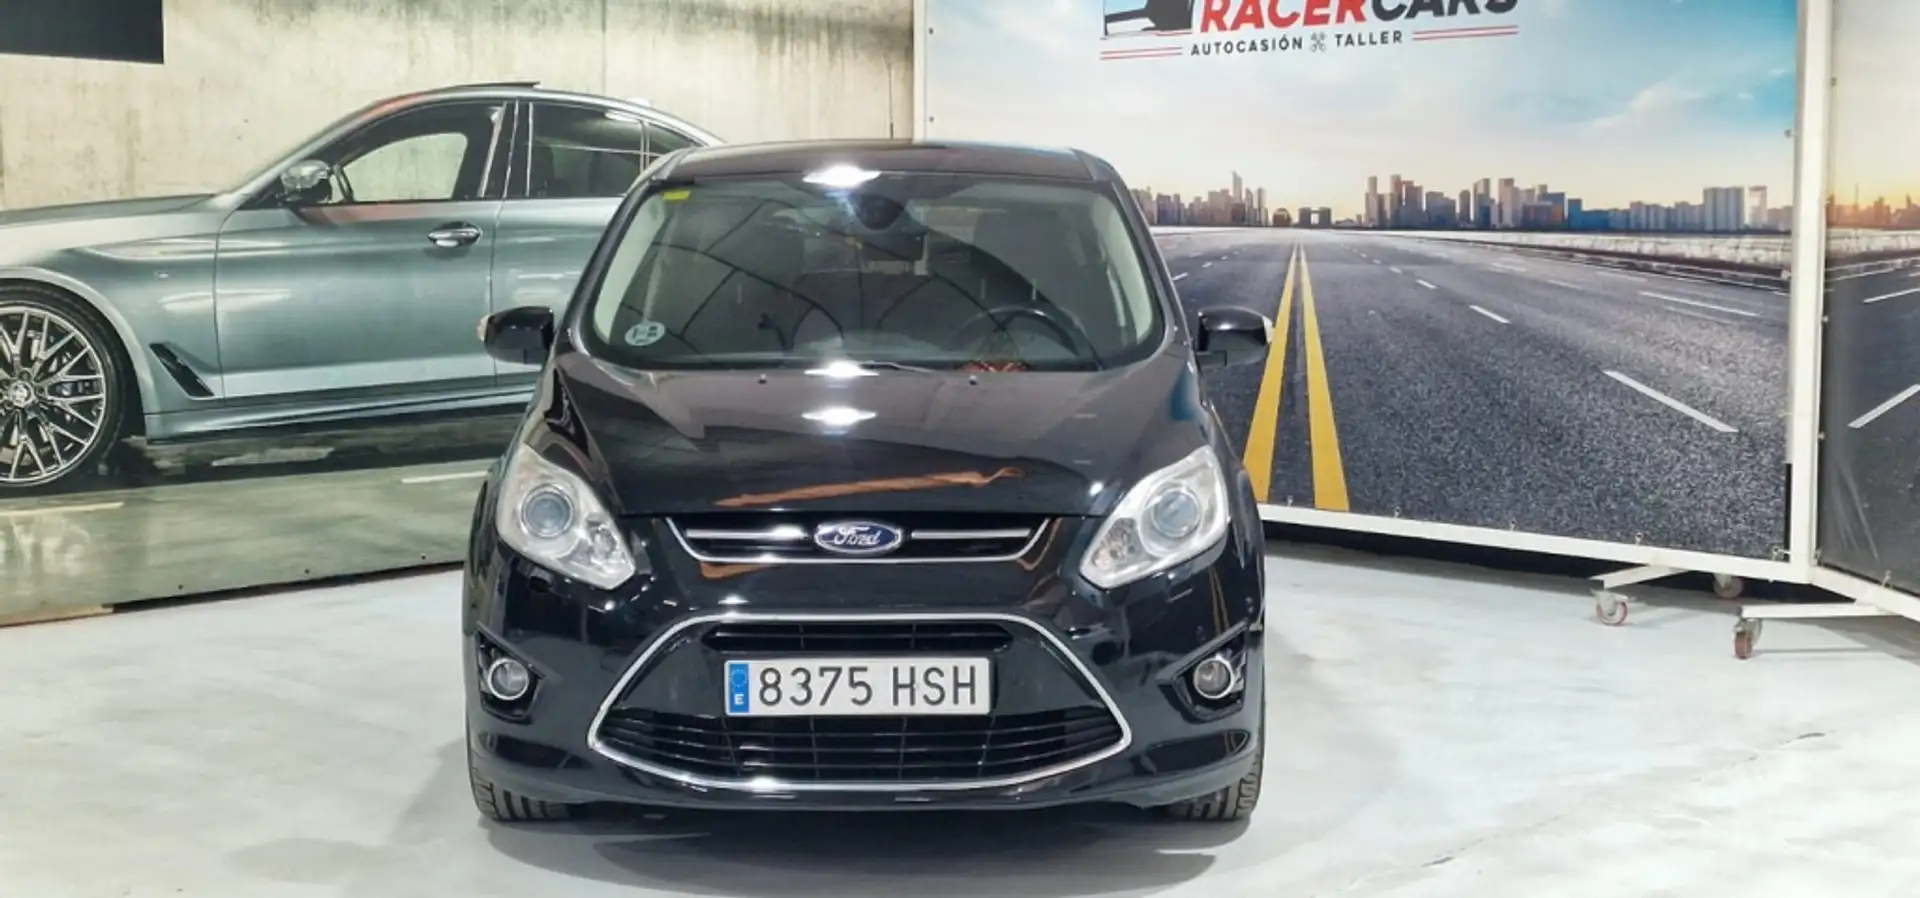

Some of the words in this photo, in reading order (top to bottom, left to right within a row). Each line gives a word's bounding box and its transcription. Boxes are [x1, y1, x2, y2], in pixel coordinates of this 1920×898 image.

[1190, 35, 1303, 56] AUTOCASIÓN
[1334, 31, 1403, 47] TALLER
[833, 526, 882, 545] Ford
[758, 666, 873, 706] 8375
[892, 665, 977, 706] HSH
[734, 693, 744, 705] E
